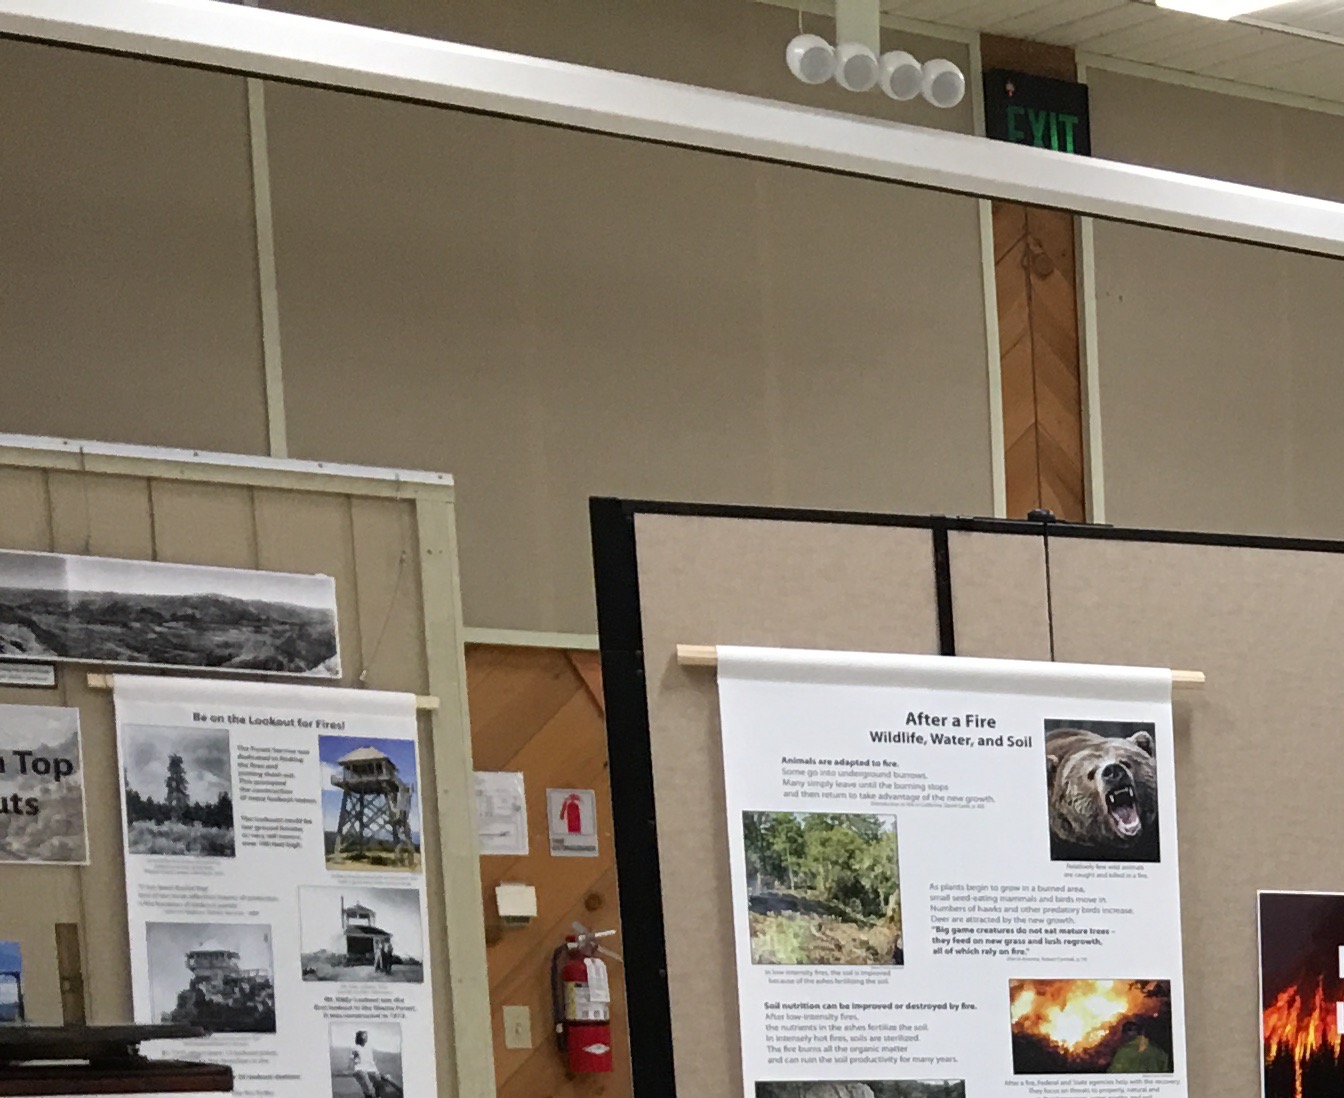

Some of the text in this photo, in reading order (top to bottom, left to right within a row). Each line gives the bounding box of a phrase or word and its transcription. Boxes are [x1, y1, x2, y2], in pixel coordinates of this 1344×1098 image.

[1006, 104, 1079, 154] EXIT
[193, 712, 345, 730] Be on the Lookout for Fires!
[906, 712, 996, 729] After a Fire
[870, 731, 1032, 748] Wildlife, Water, and Soil
[12, 750, 74, 782] Top
